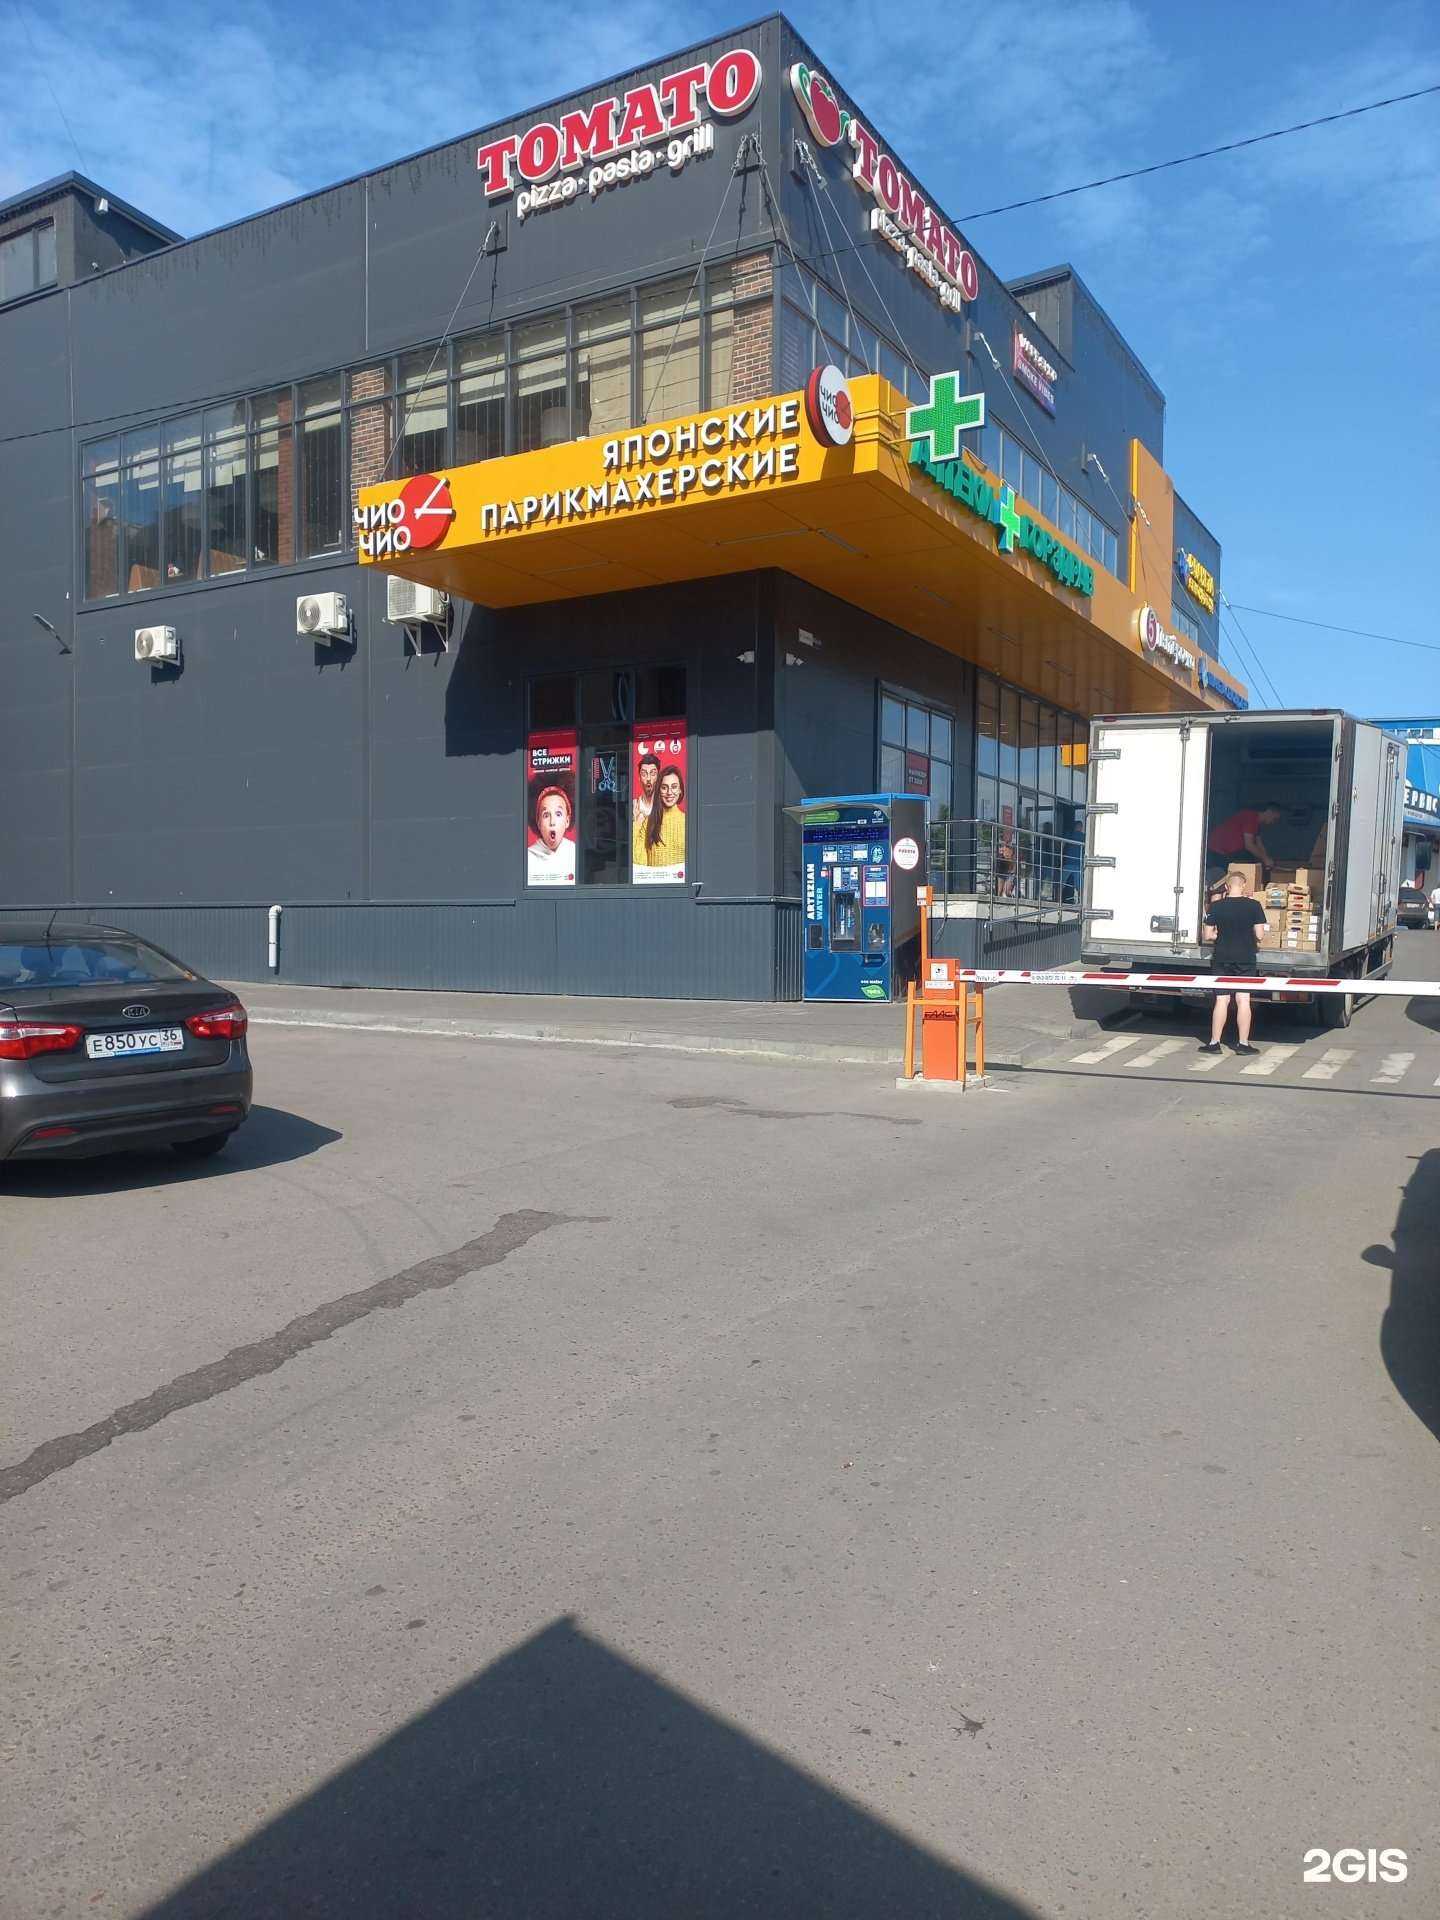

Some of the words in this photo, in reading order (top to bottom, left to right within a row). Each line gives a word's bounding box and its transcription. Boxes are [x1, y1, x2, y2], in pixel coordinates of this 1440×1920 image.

[477, 49, 762, 196] TOMATO
[849, 119, 979, 301] TOMATO
[602, 399, 799, 471] ЯПОНСКИЕ
[354, 499, 406, 529] ЧИО
[480, 443, 799, 532] ПАРИКМАХЕРСКИЕ
[359, 526, 411, 556] ЧИО
[532, 749, 548, 757] ВСЕ
[532, 756, 571, 766] СТРИЖКИ
[806, 863, 815, 920] ARTEZIAN
